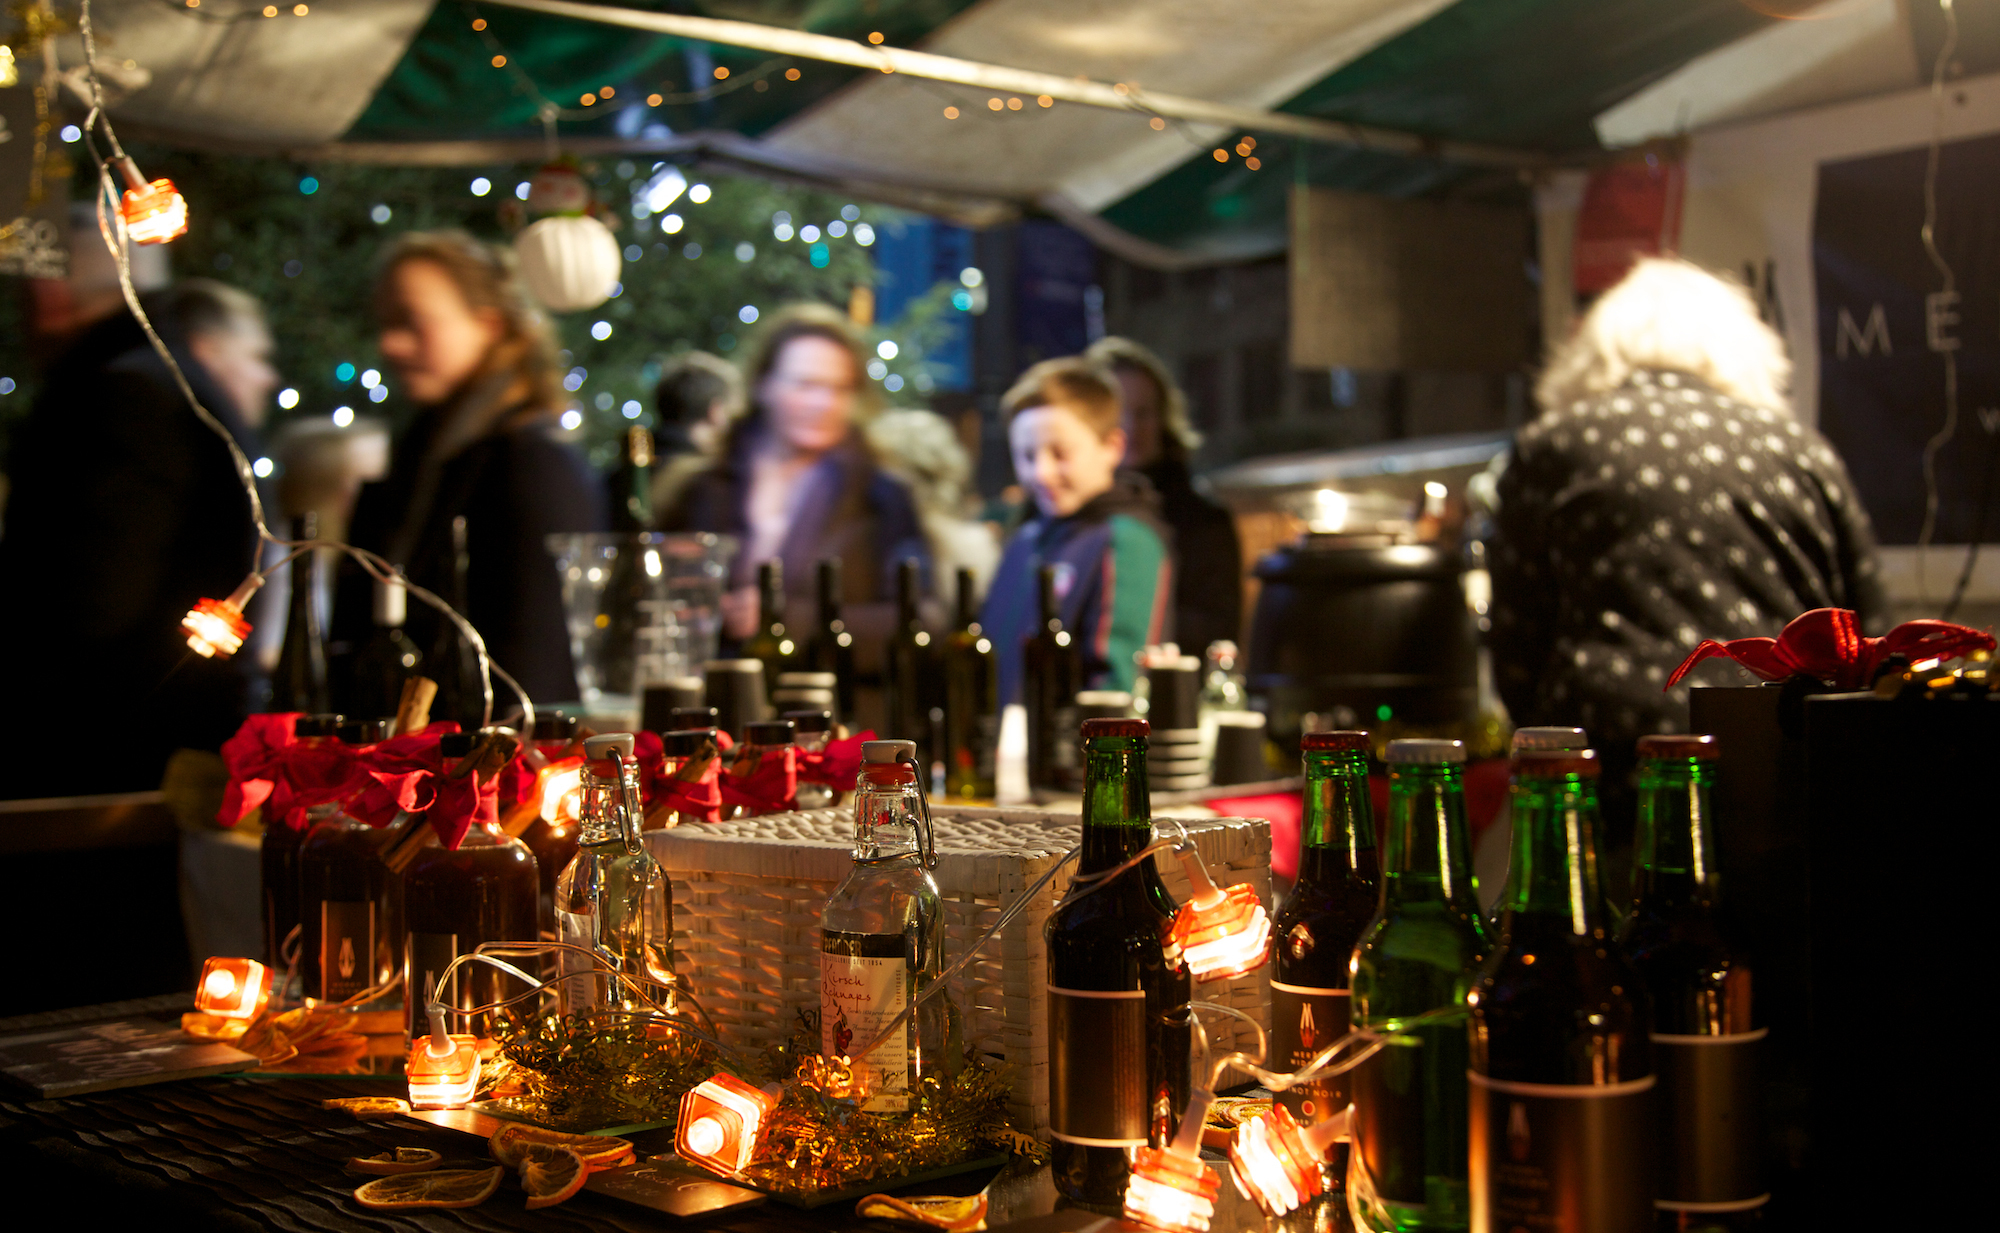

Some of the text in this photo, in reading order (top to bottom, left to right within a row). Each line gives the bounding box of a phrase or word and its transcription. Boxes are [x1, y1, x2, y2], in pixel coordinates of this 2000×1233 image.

[1836, 290, 1962, 359] ME
[824, 957, 865, 987] Kirsch
[822, 981, 871, 1012] Schnaps
[1287, 1085, 1342, 1099] INOT NOIR
